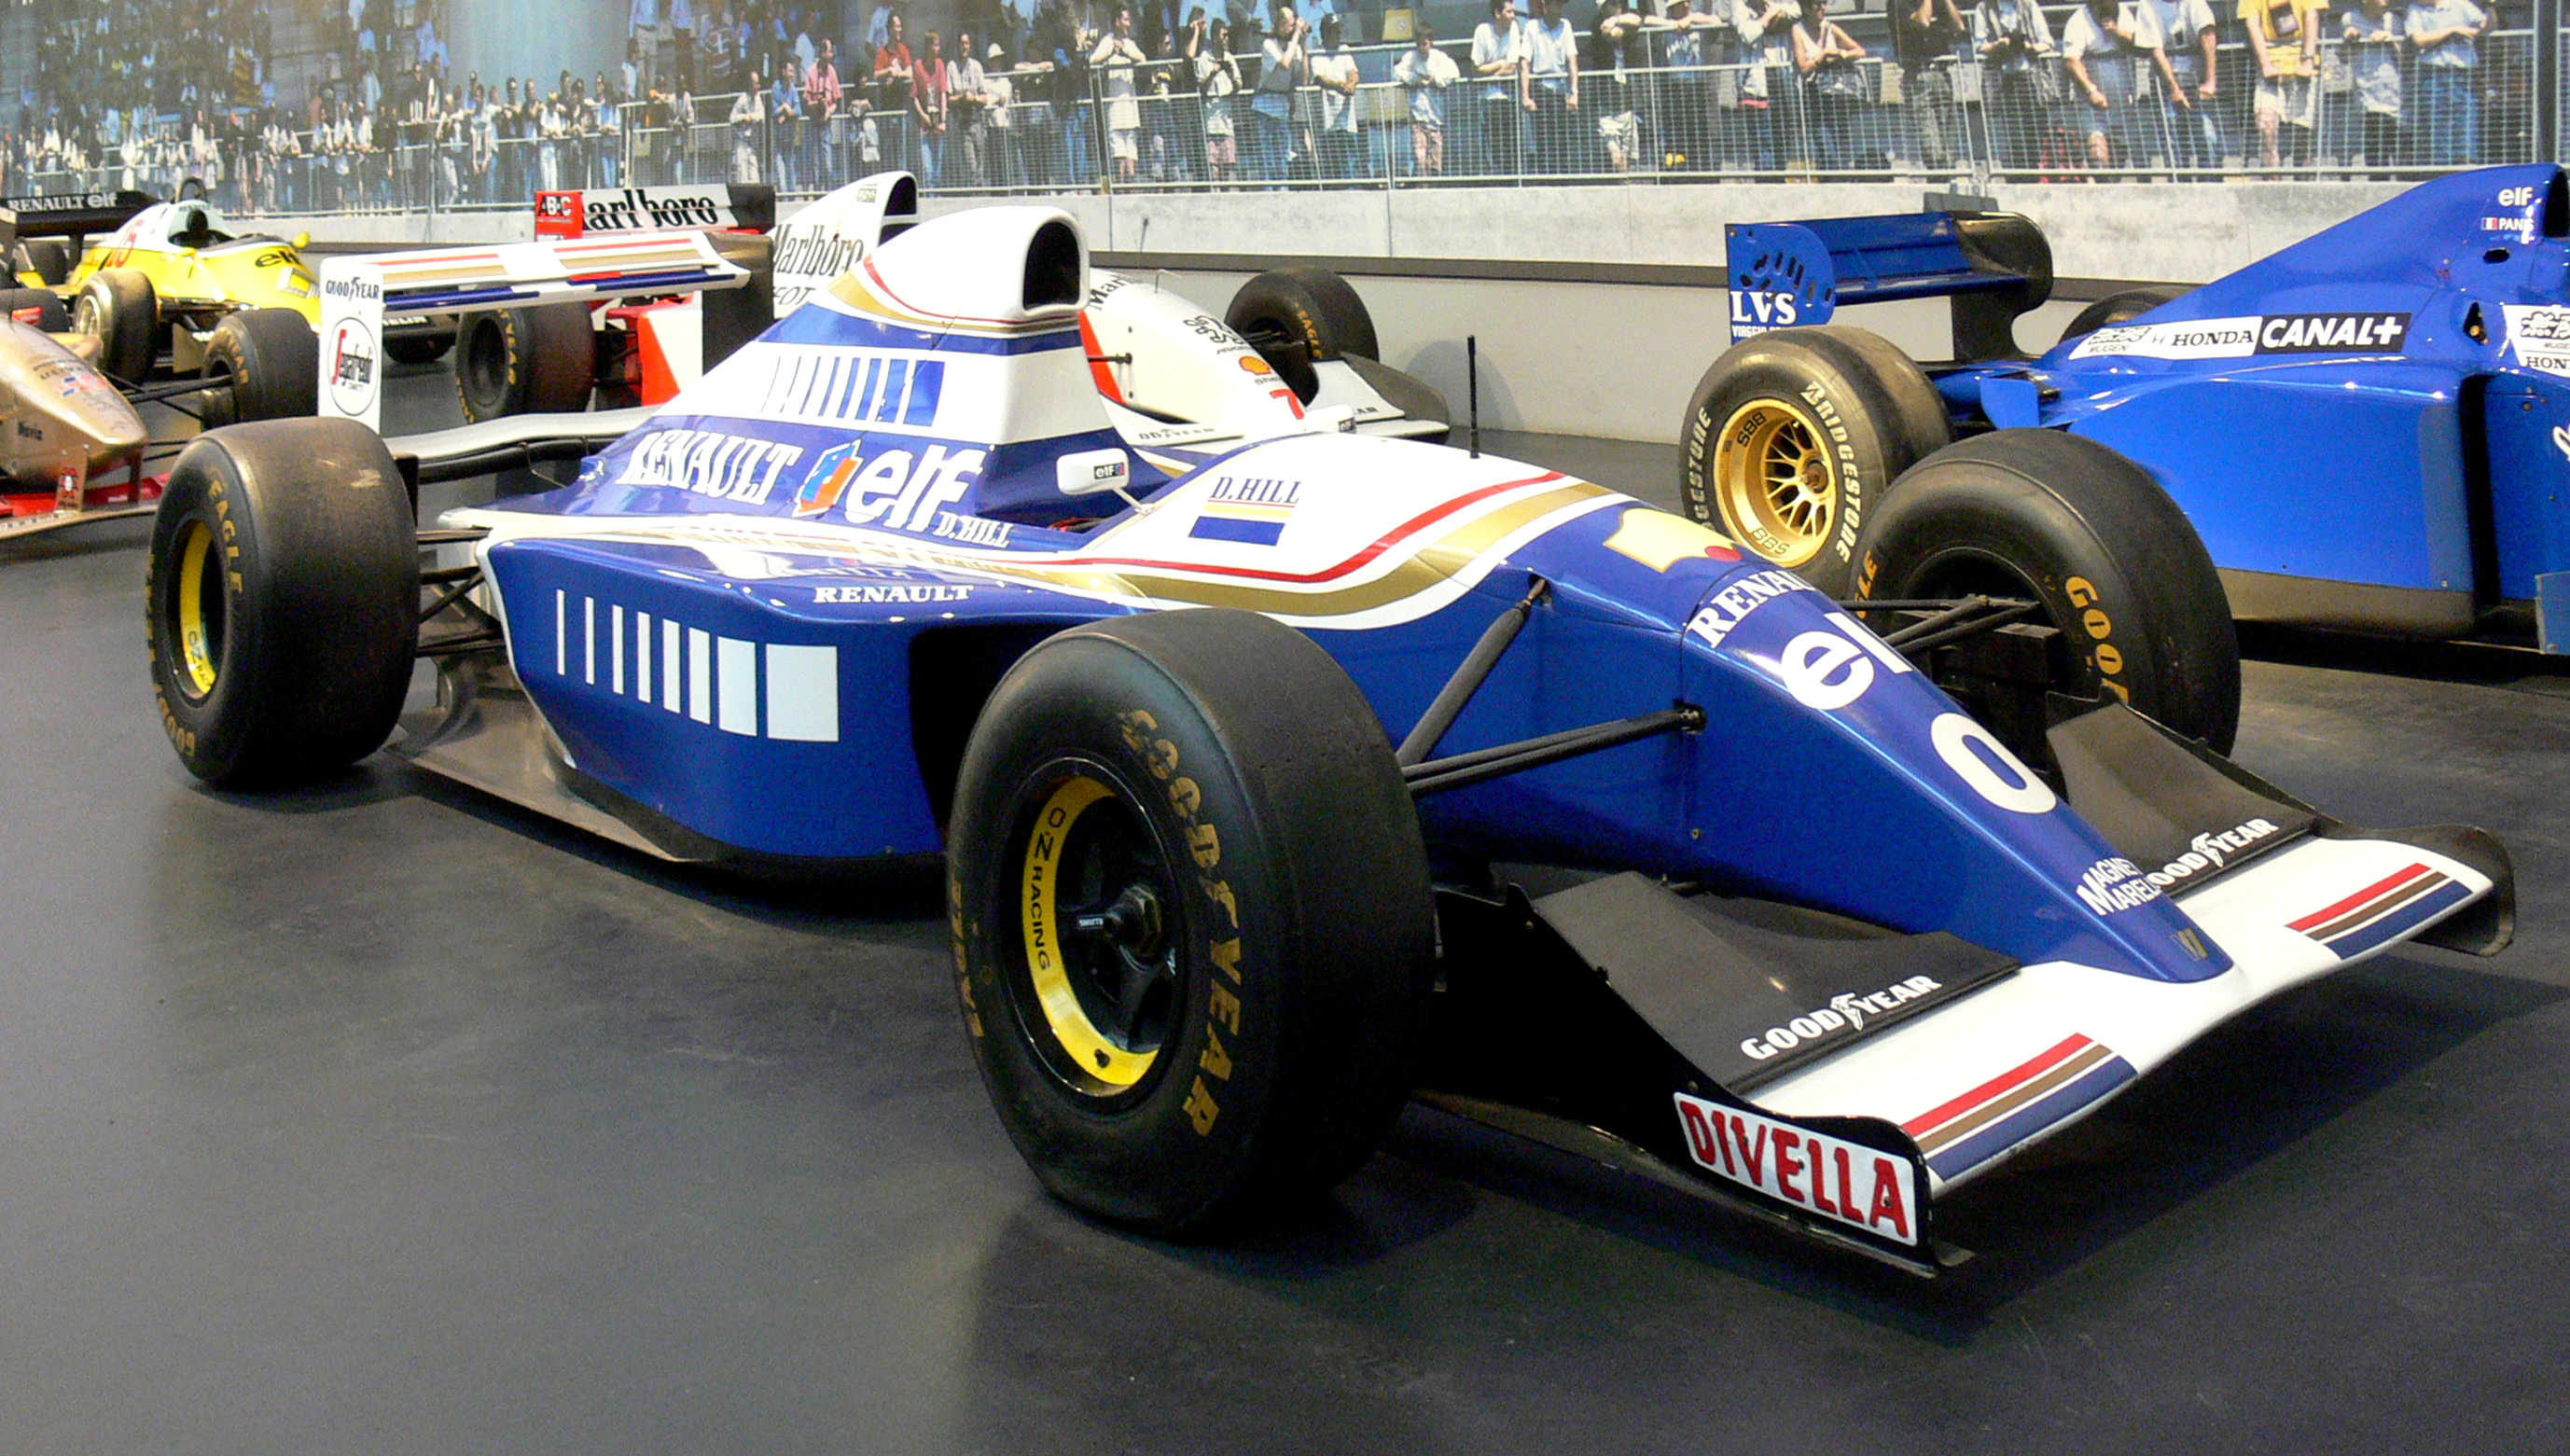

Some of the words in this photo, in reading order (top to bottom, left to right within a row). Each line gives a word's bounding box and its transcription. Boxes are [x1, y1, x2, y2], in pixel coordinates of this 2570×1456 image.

[7, 195, 86, 212] RENAULT
[87, 191, 118, 208] elf
[582, 189, 718, 230] arlboro
[2498, 187, 2534, 207] elf
[1730, 291, 1797, 325] LVS
[2171, 330, 2254, 346] HONDA
[2261, 316, 2403, 349] CANAL+
[2526, 356, 2570, 370] HON
[1269, 388, 1305, 421] 7
[1736, 412, 1768, 449] BBS
[615, 429, 804, 506] RENAULT
[844, 444, 987, 533] elf
[1096, 465, 1116, 478] elf
[1800, 381, 1863, 563] BRIDGESTONE
[1209, 477, 1302, 504] D.HILL
[932, 511, 1014, 548] D.HILL
[1751, 526, 1791, 557] BBS
[813, 585, 974, 604] RENAULT
[1781, 612, 1912, 711] el
[1931, 712, 2057, 814] 0
[2146, 818, 2279, 886] OODYEAR
[1031, 866, 1050, 970] RACING
[1119, 709, 1242, 1137] GOODYEAR
[1741, 976, 1942, 1060] GOODYEAR
[1680, 1100, 1910, 1239] DIVELLA
